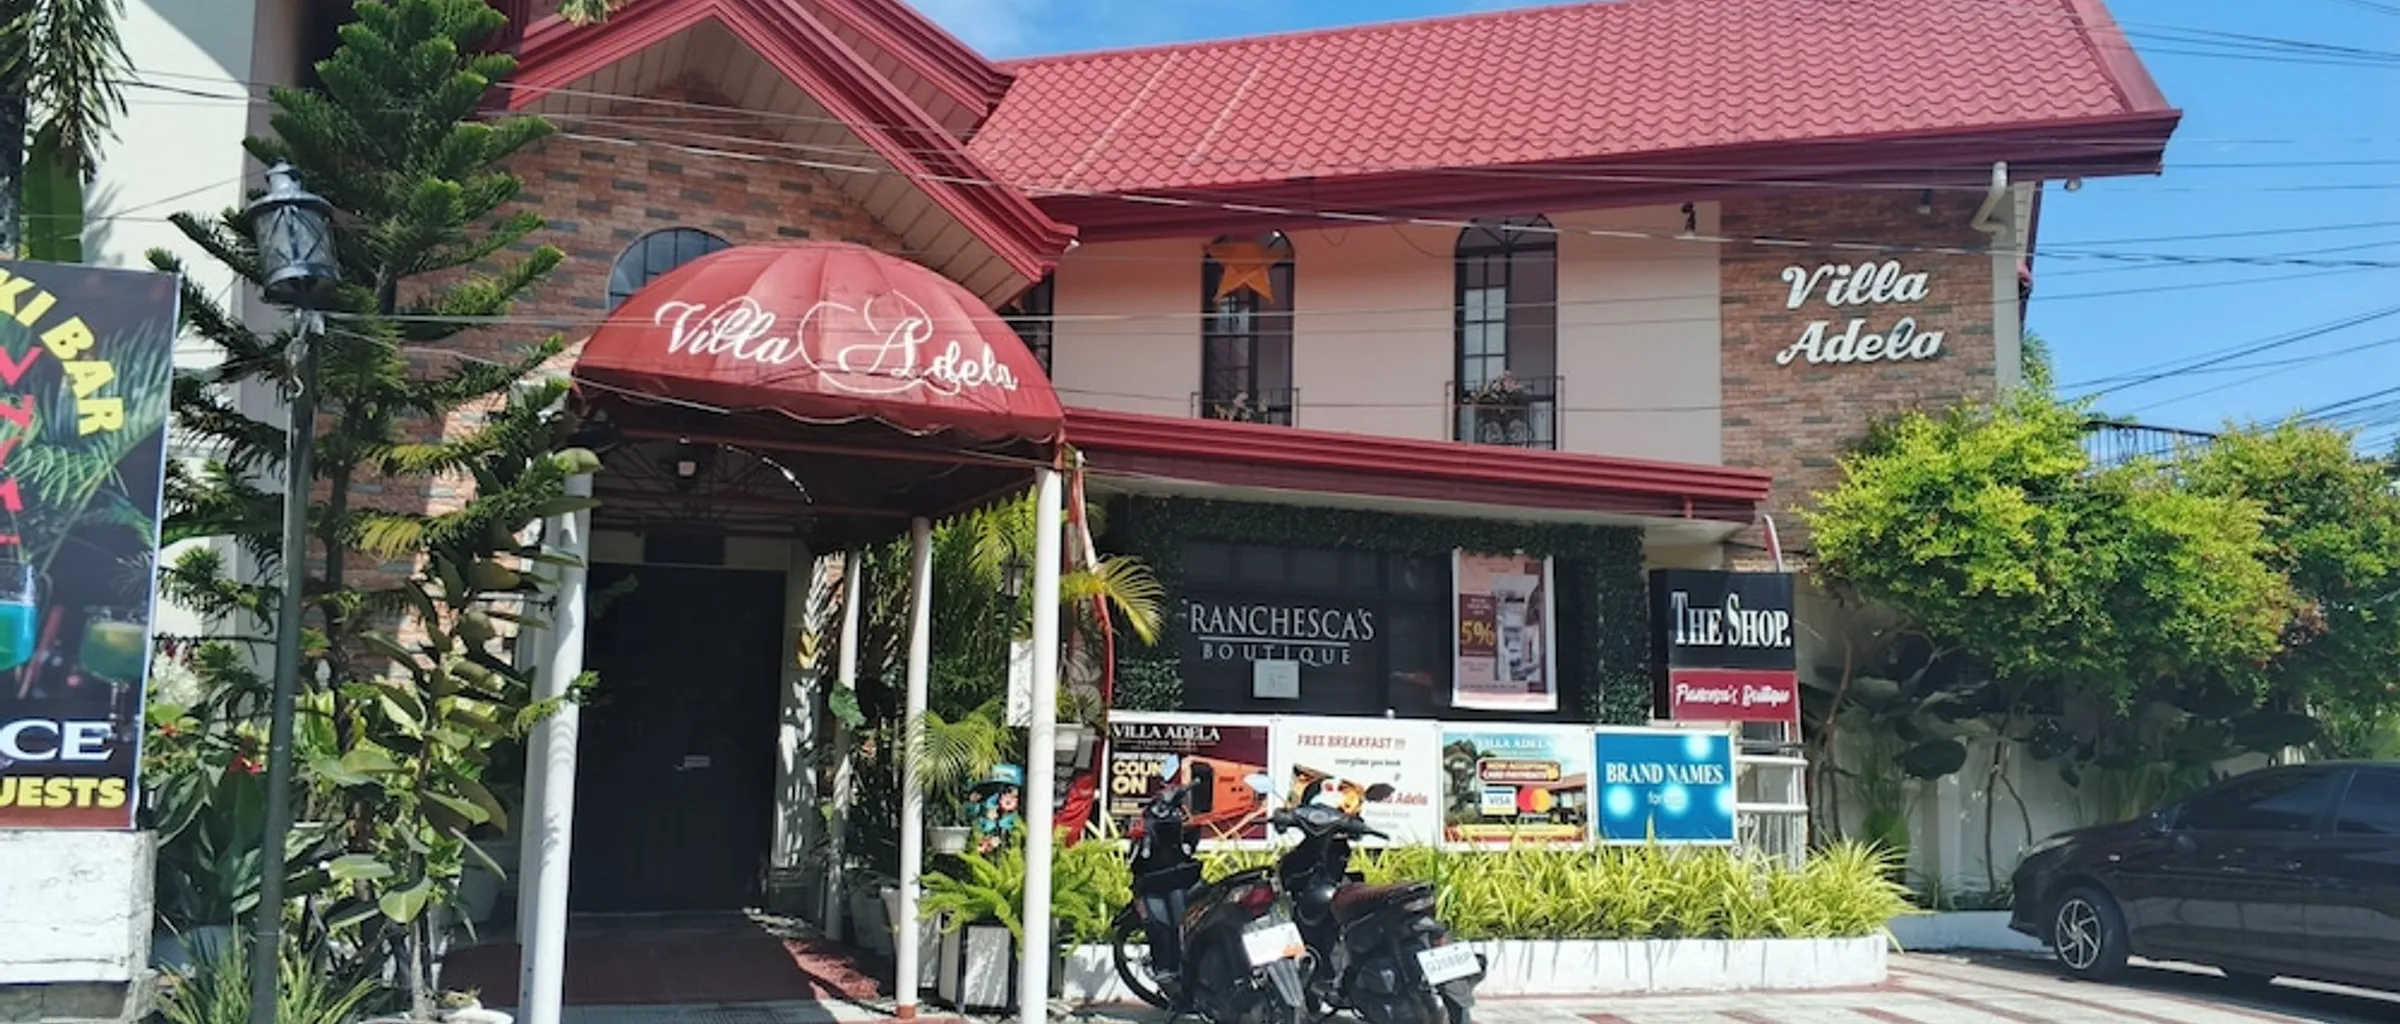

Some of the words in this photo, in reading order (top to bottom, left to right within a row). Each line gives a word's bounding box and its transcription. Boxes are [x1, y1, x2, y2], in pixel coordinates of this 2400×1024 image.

[1781, 260, 1930, 309] Villa
[655, 295, 801, 364] Villa
[1776, 316, 1945, 365] Adela
[40, 315, 124, 436] BAR
[1461, 619, 1496, 647] 5%
[1202, 641, 1351, 667] BOUTIQUE
[1111, 724, 1162, 739] VILLA
[1164, 725, 1220, 741] ADELA
[1296, 733, 1325, 747] FREE
[1327, 734, 1392, 749] BREAKFAST
[1112, 775, 1148, 795] ON
[1605, 762, 1664, 784] BRAND
[1666, 763, 1725, 785] NAMES
